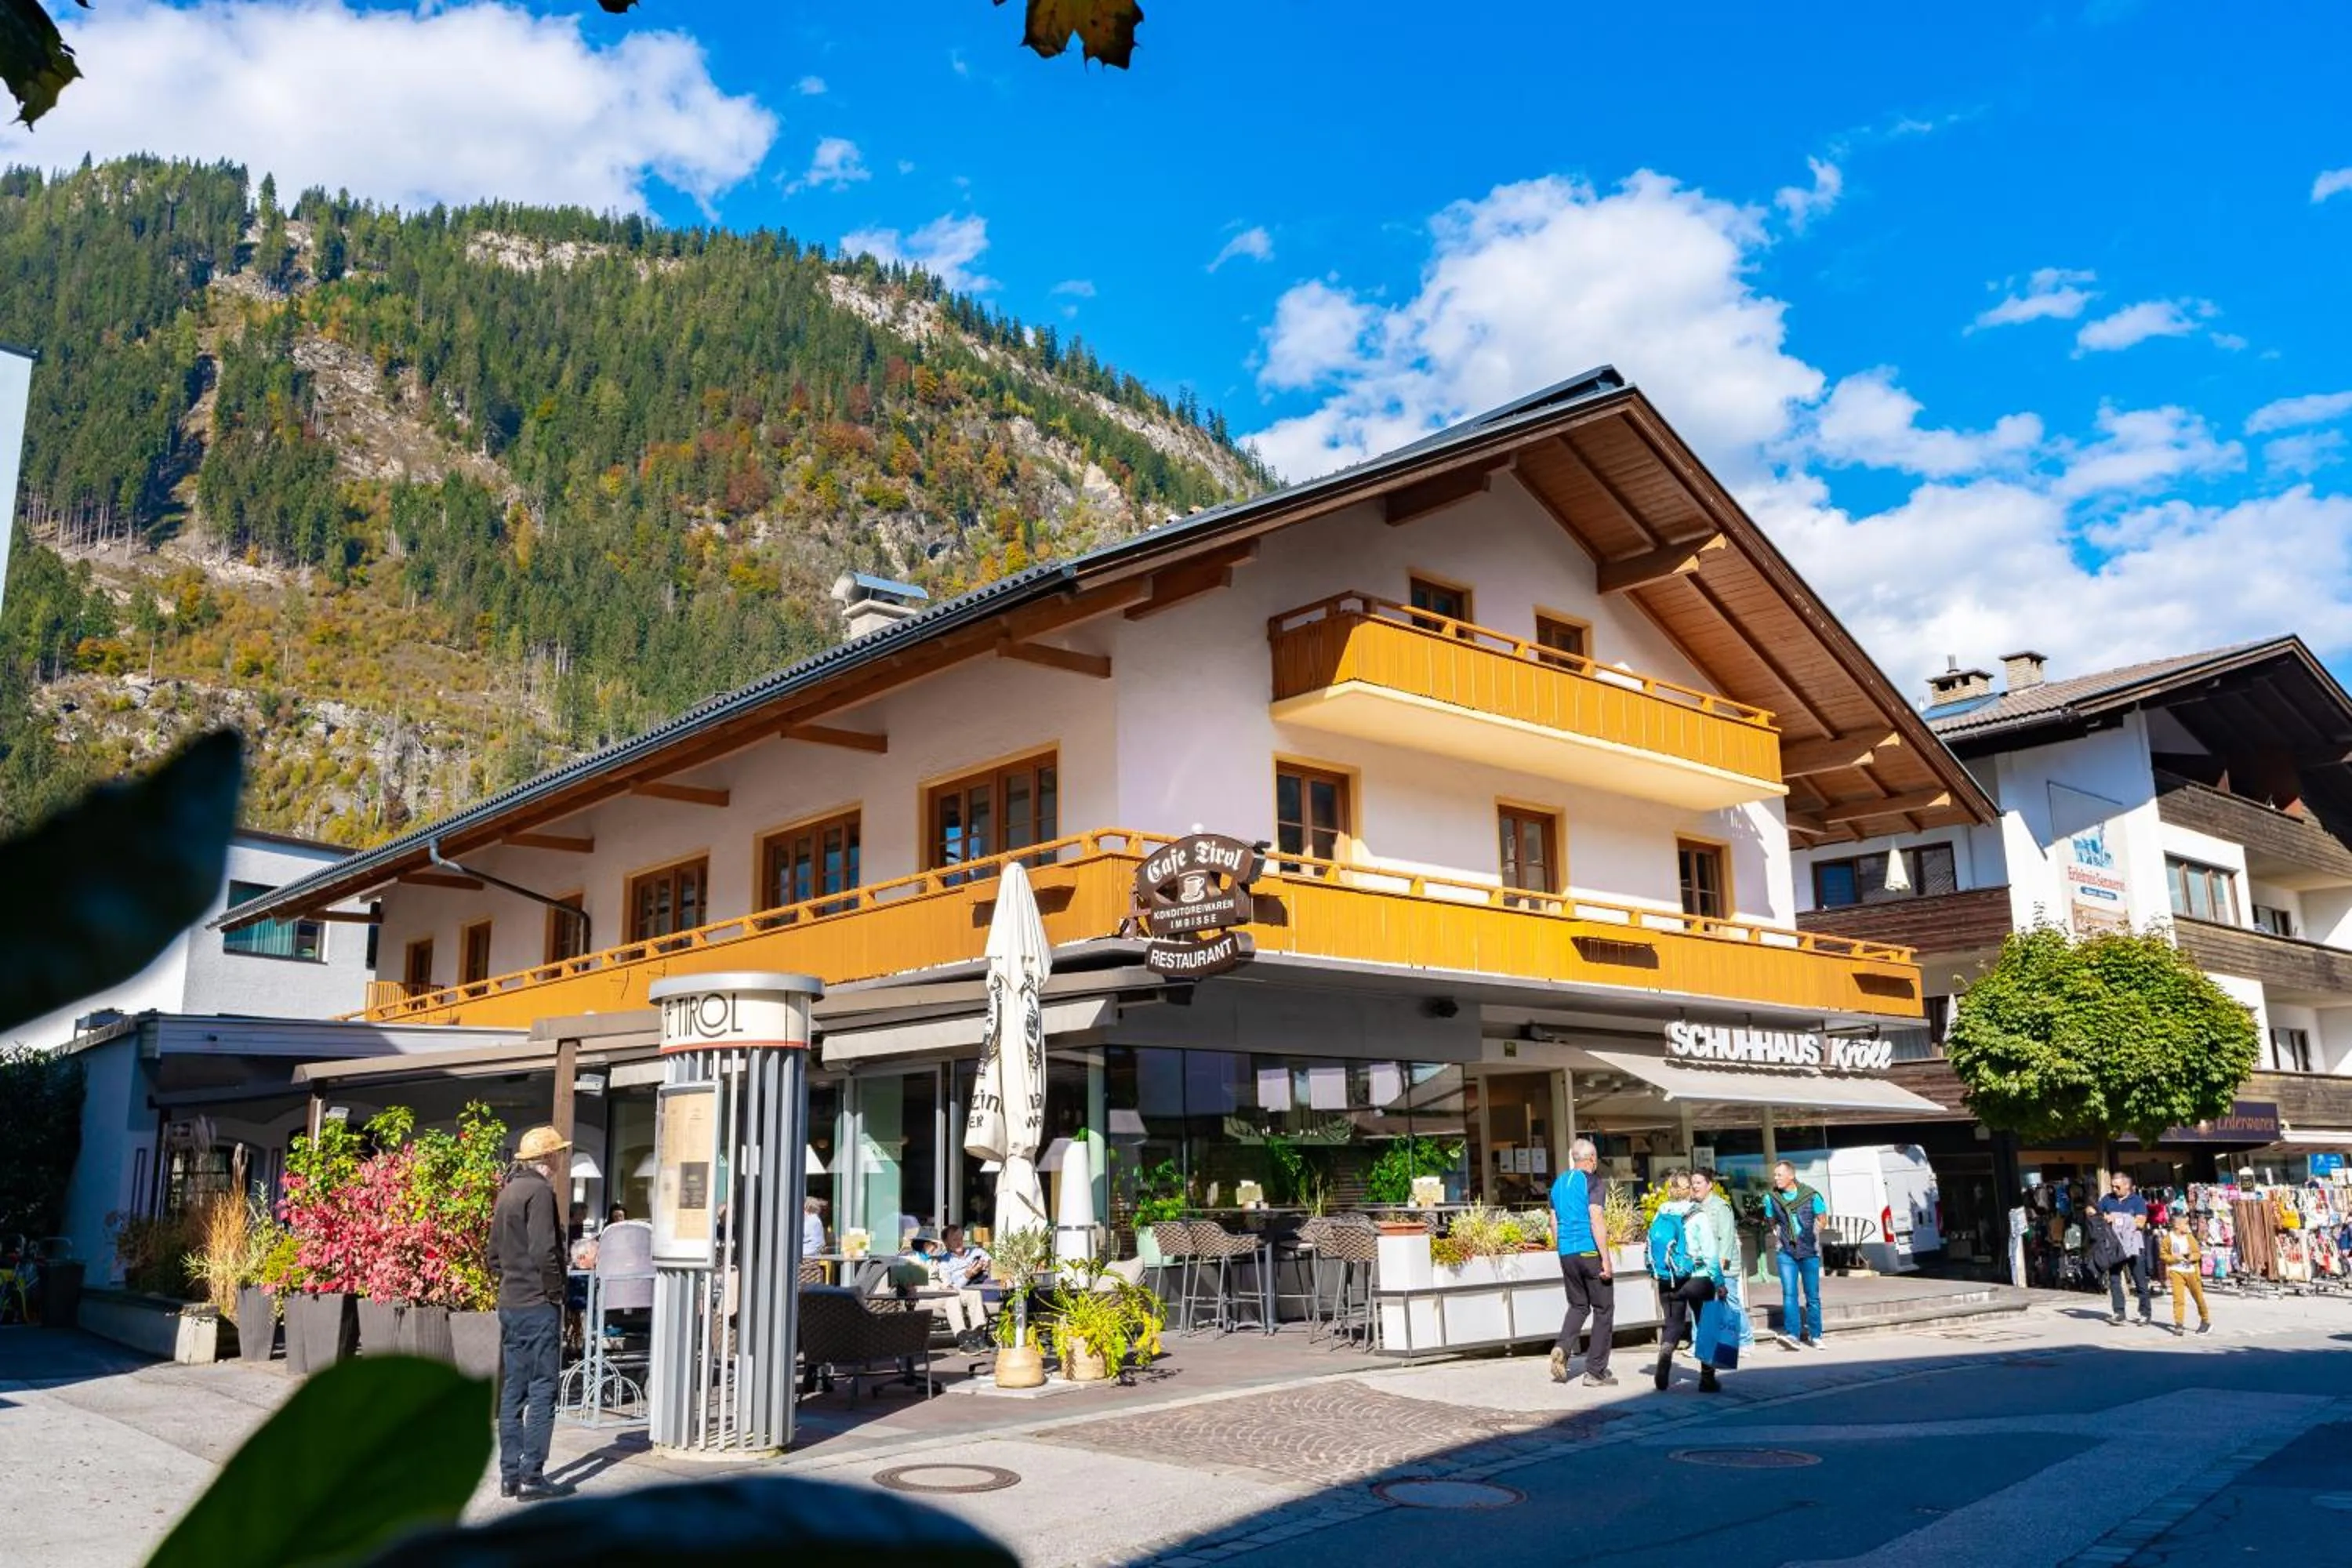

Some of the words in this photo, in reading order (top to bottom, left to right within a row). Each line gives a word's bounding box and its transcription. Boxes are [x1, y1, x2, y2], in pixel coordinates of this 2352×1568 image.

[1194, 840, 1244, 871] Tirol
[1153, 898, 1234, 920] KONDITOREIWAREN
[1170, 913, 1218, 929] IMBISSE
[1150, 938, 1232, 969] RESTAURANT
[677, 992, 744, 1038] TIROL
[1666, 1022, 1822, 1065] SCHUHHAUS
[1830, 1036, 1893, 1071] Kröll
